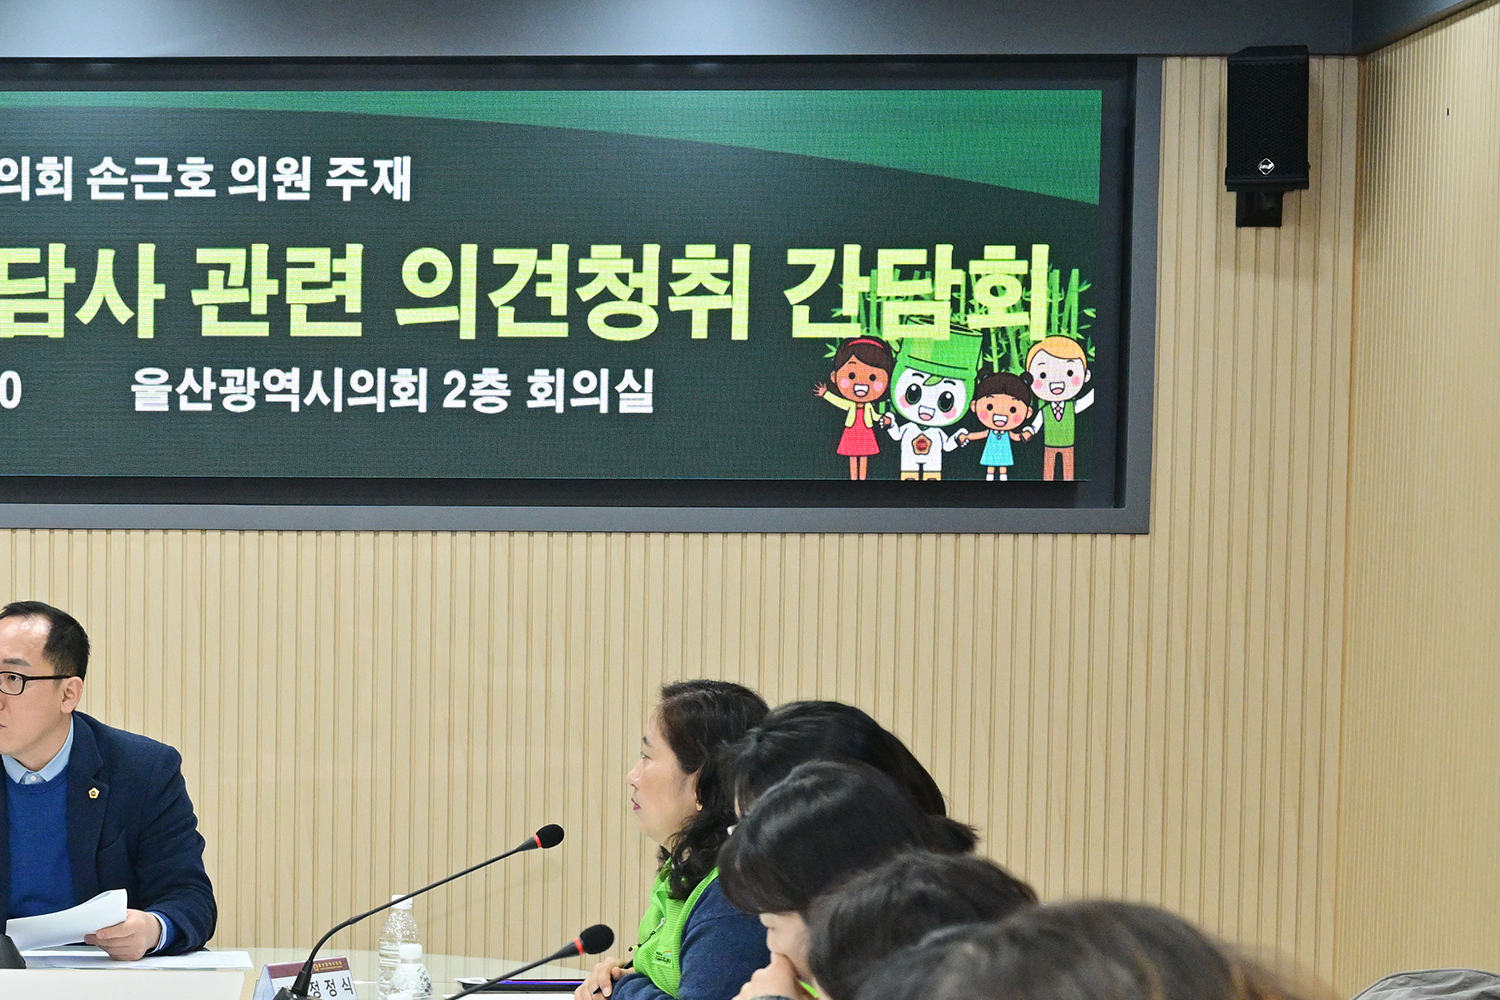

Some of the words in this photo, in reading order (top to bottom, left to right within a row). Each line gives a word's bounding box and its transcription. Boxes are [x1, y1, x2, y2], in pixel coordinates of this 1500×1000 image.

[86, 156, 217, 202] 손근호
[227, 155, 313, 202] 의원
[325, 155, 412, 202] 주재
[191, 243, 364, 338] 관련
[395, 243, 751, 342] 의견청취
[783, 244, 1049, 341] 간담회
[130, 366, 428, 414] 울산광역시의회
[442, 367, 512, 414] 2층
[526, 367, 655, 414] 회의실
